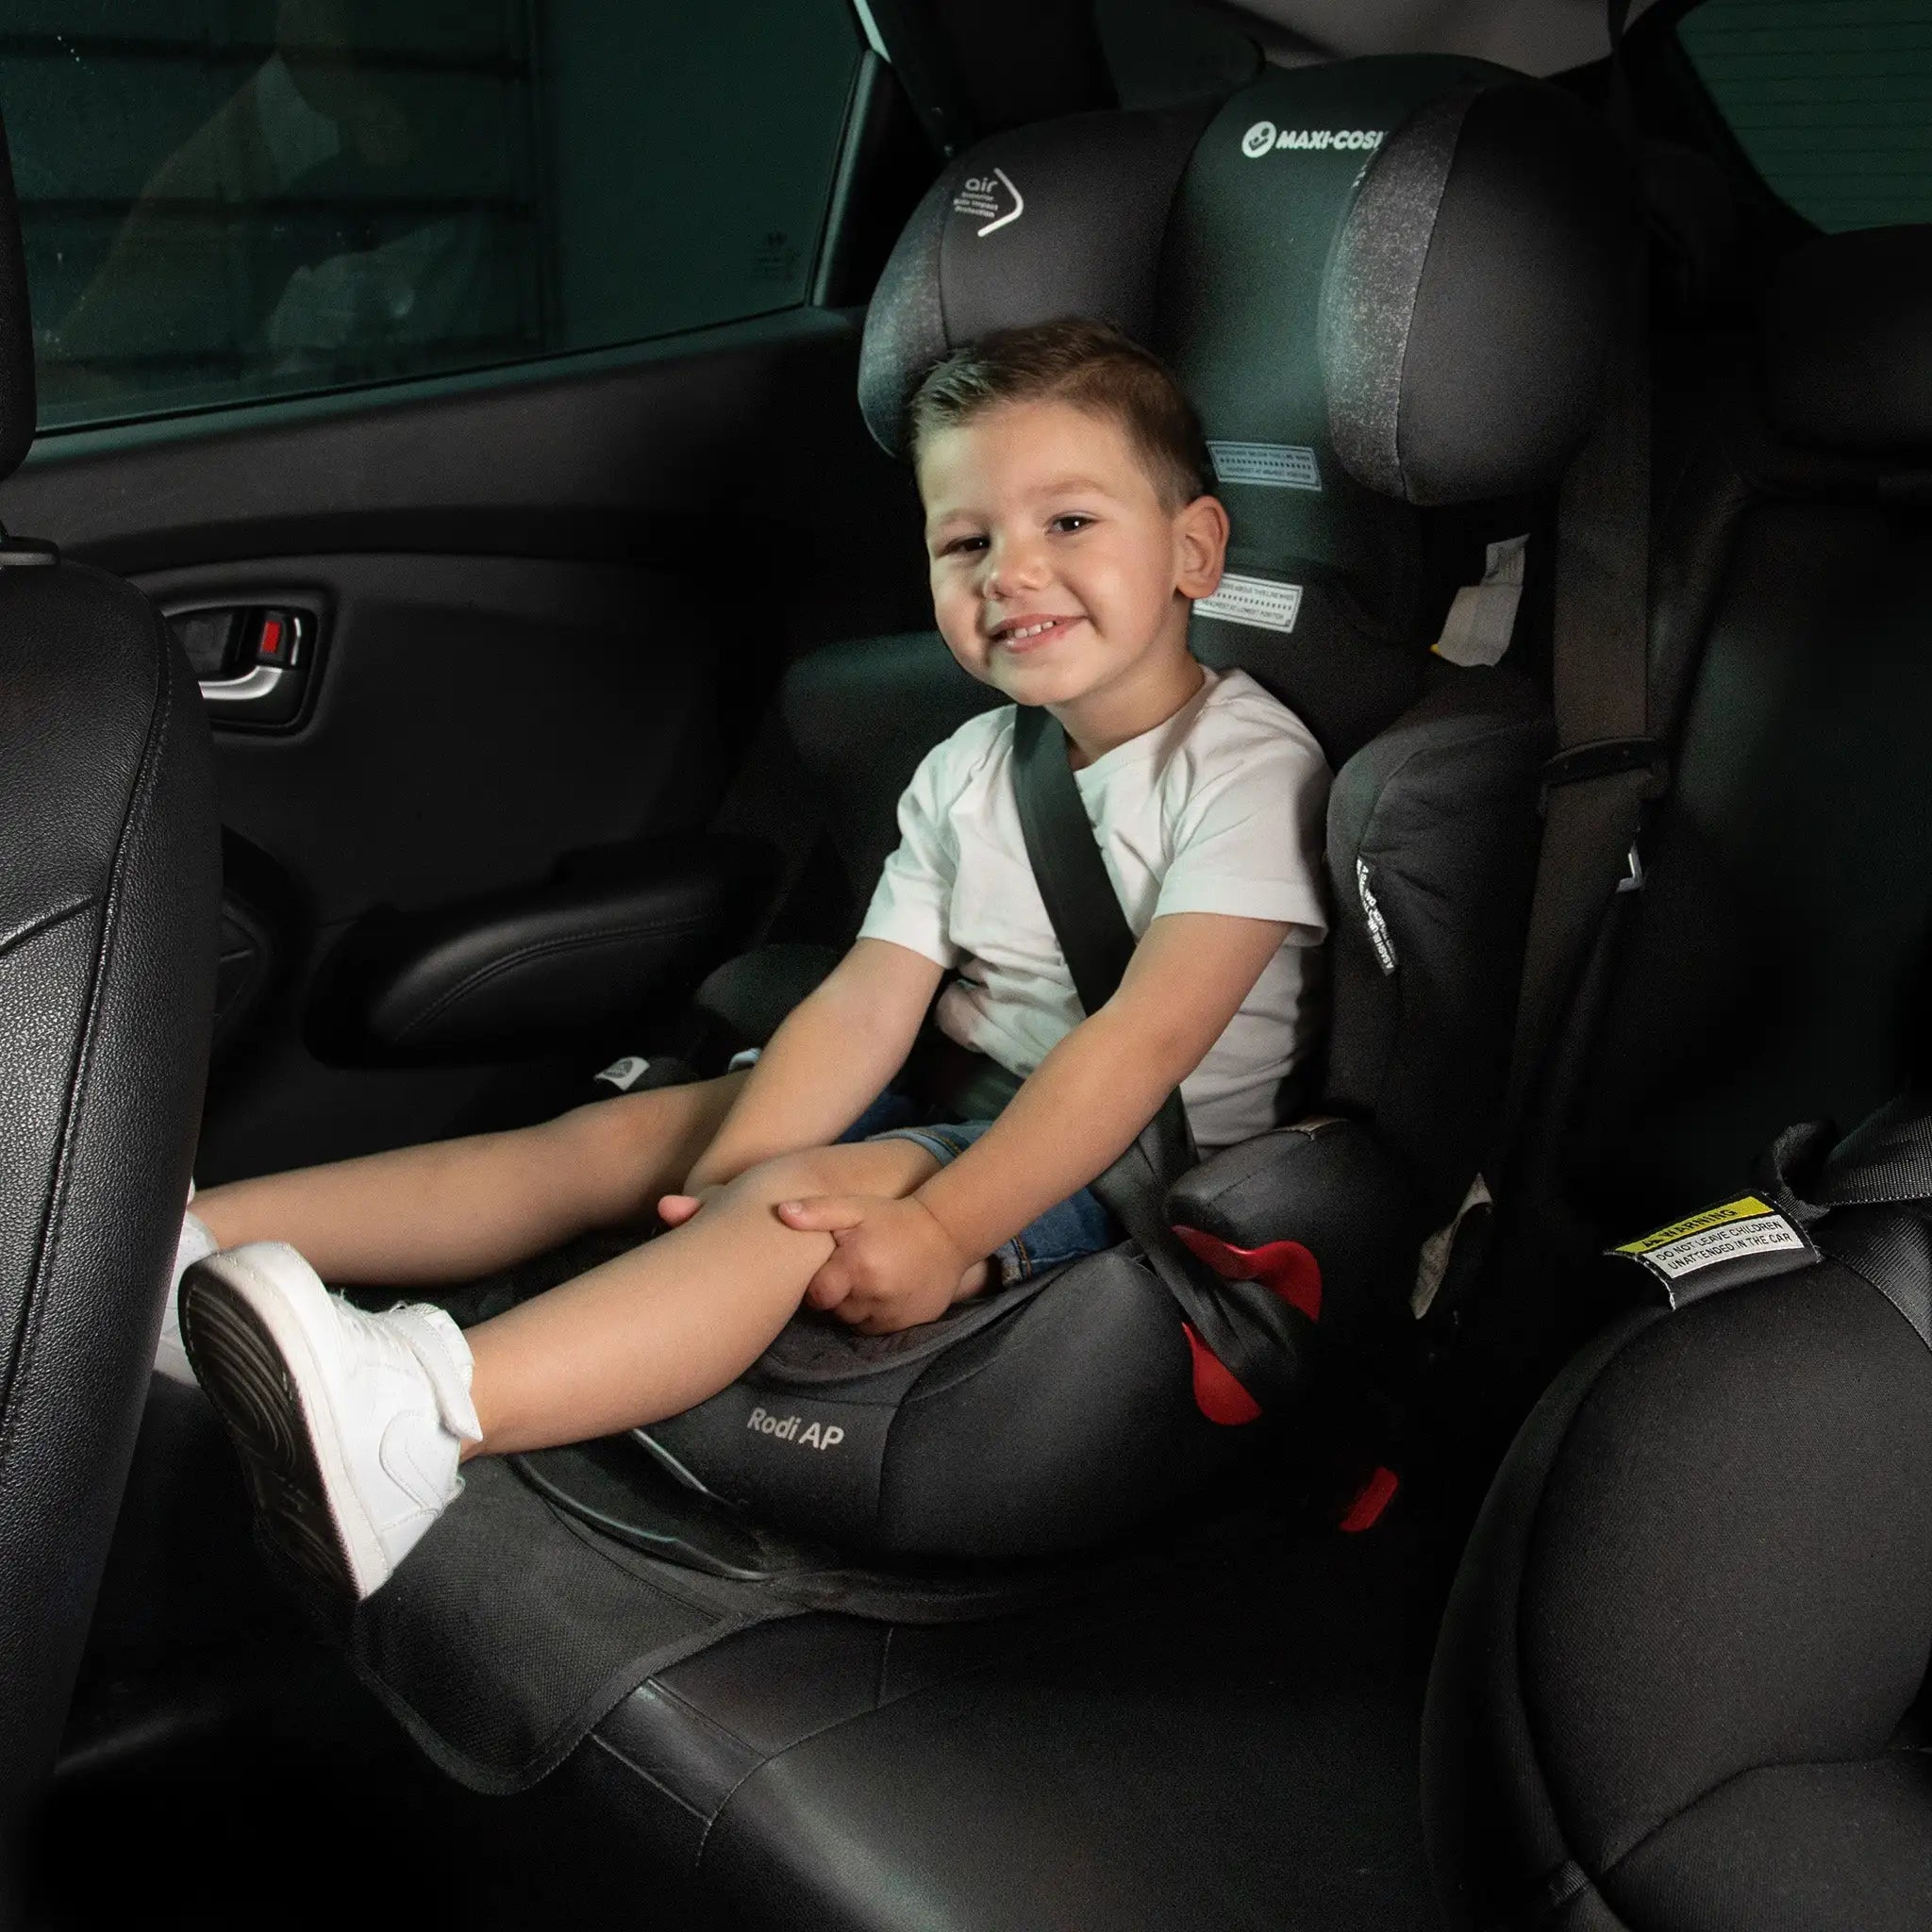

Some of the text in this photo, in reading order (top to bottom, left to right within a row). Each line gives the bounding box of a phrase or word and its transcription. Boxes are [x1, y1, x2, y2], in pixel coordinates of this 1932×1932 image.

[965, 177, 999, 193] air
[1656, 1221, 1784, 1262] DO NOT LEAVE CHILDREN
[1660, 1208, 1739, 1241] WARNING
[1668, 1232, 1793, 1270] UNATTENDED IN THE CAR
[747, 1407, 844, 1451] Rodi AP
